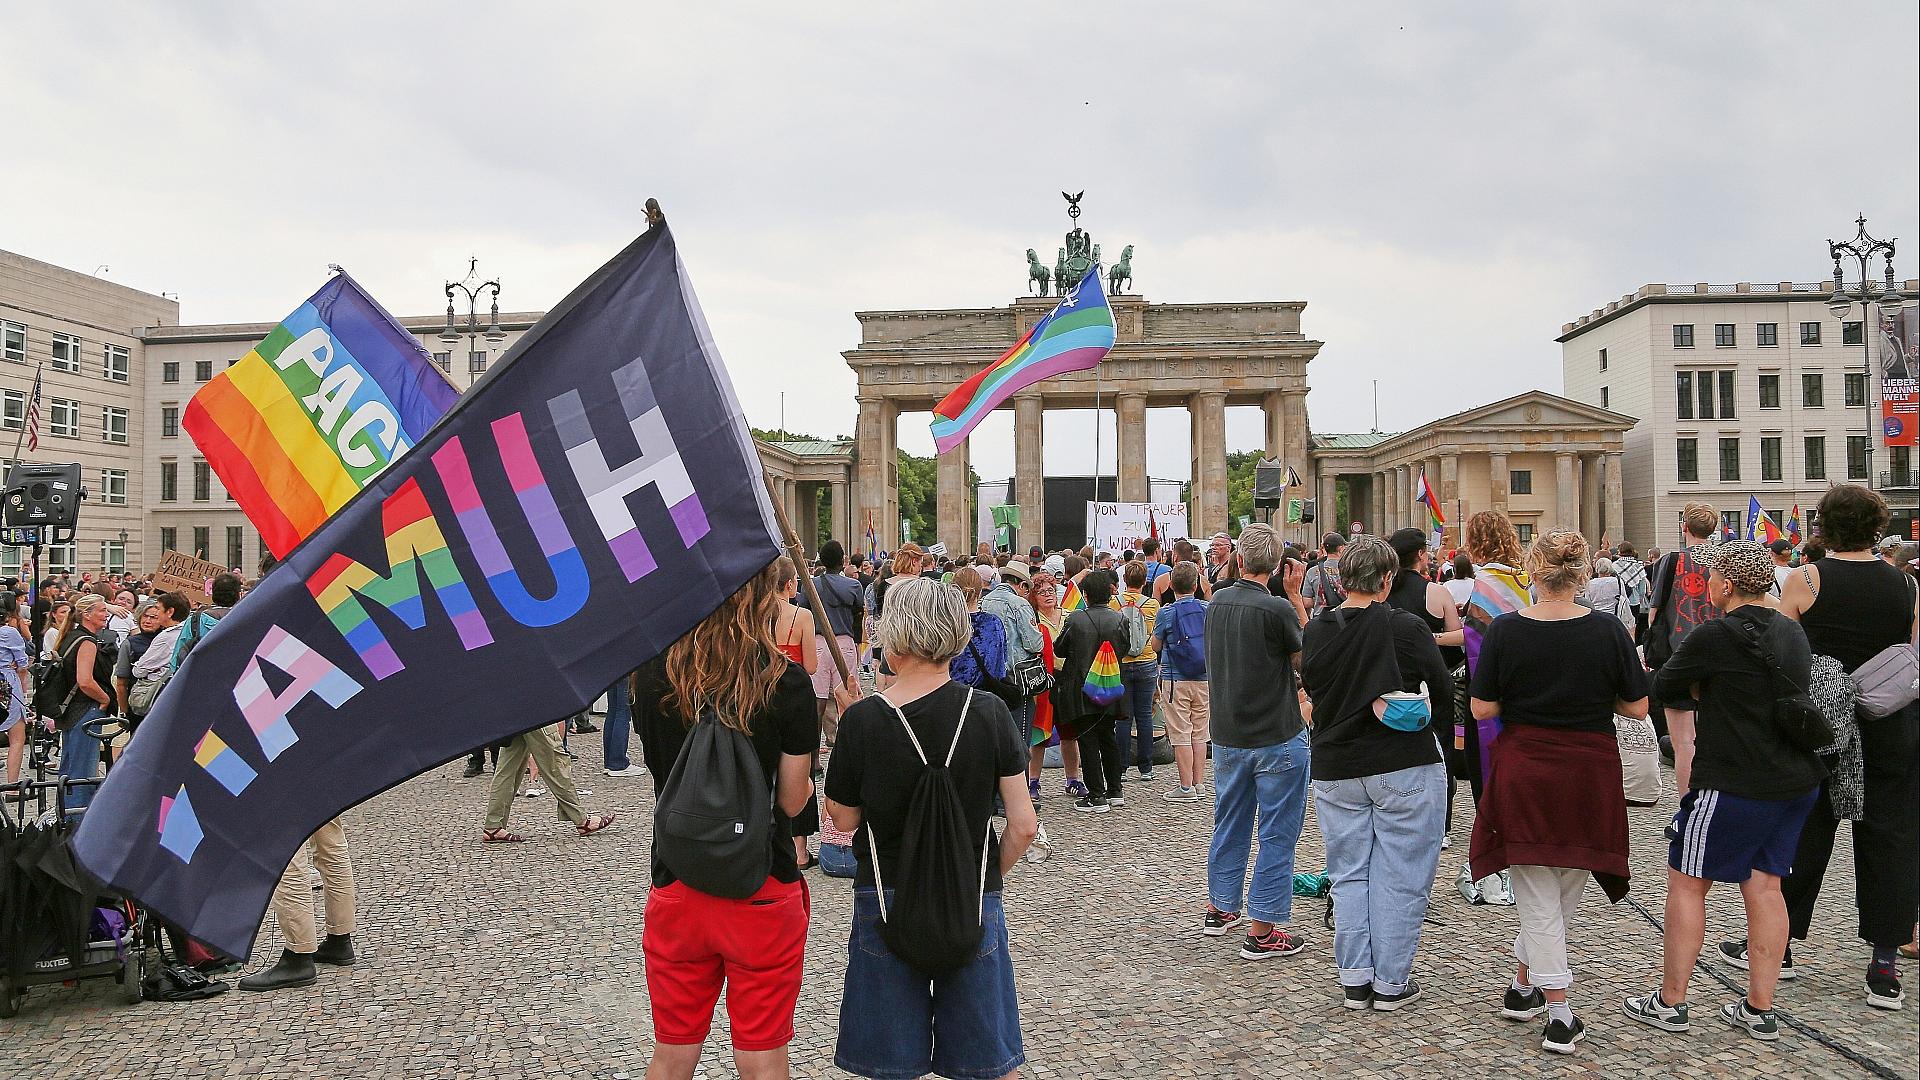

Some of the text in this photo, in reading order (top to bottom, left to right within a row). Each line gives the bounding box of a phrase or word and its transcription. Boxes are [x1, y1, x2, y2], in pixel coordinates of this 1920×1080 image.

[1093, 504, 1186, 516] VON TRAUER
[1123, 521, 1142, 532] ZU
[165, 554, 190, 570] ARE
[35, 958, 70, 968] FUXTEC
